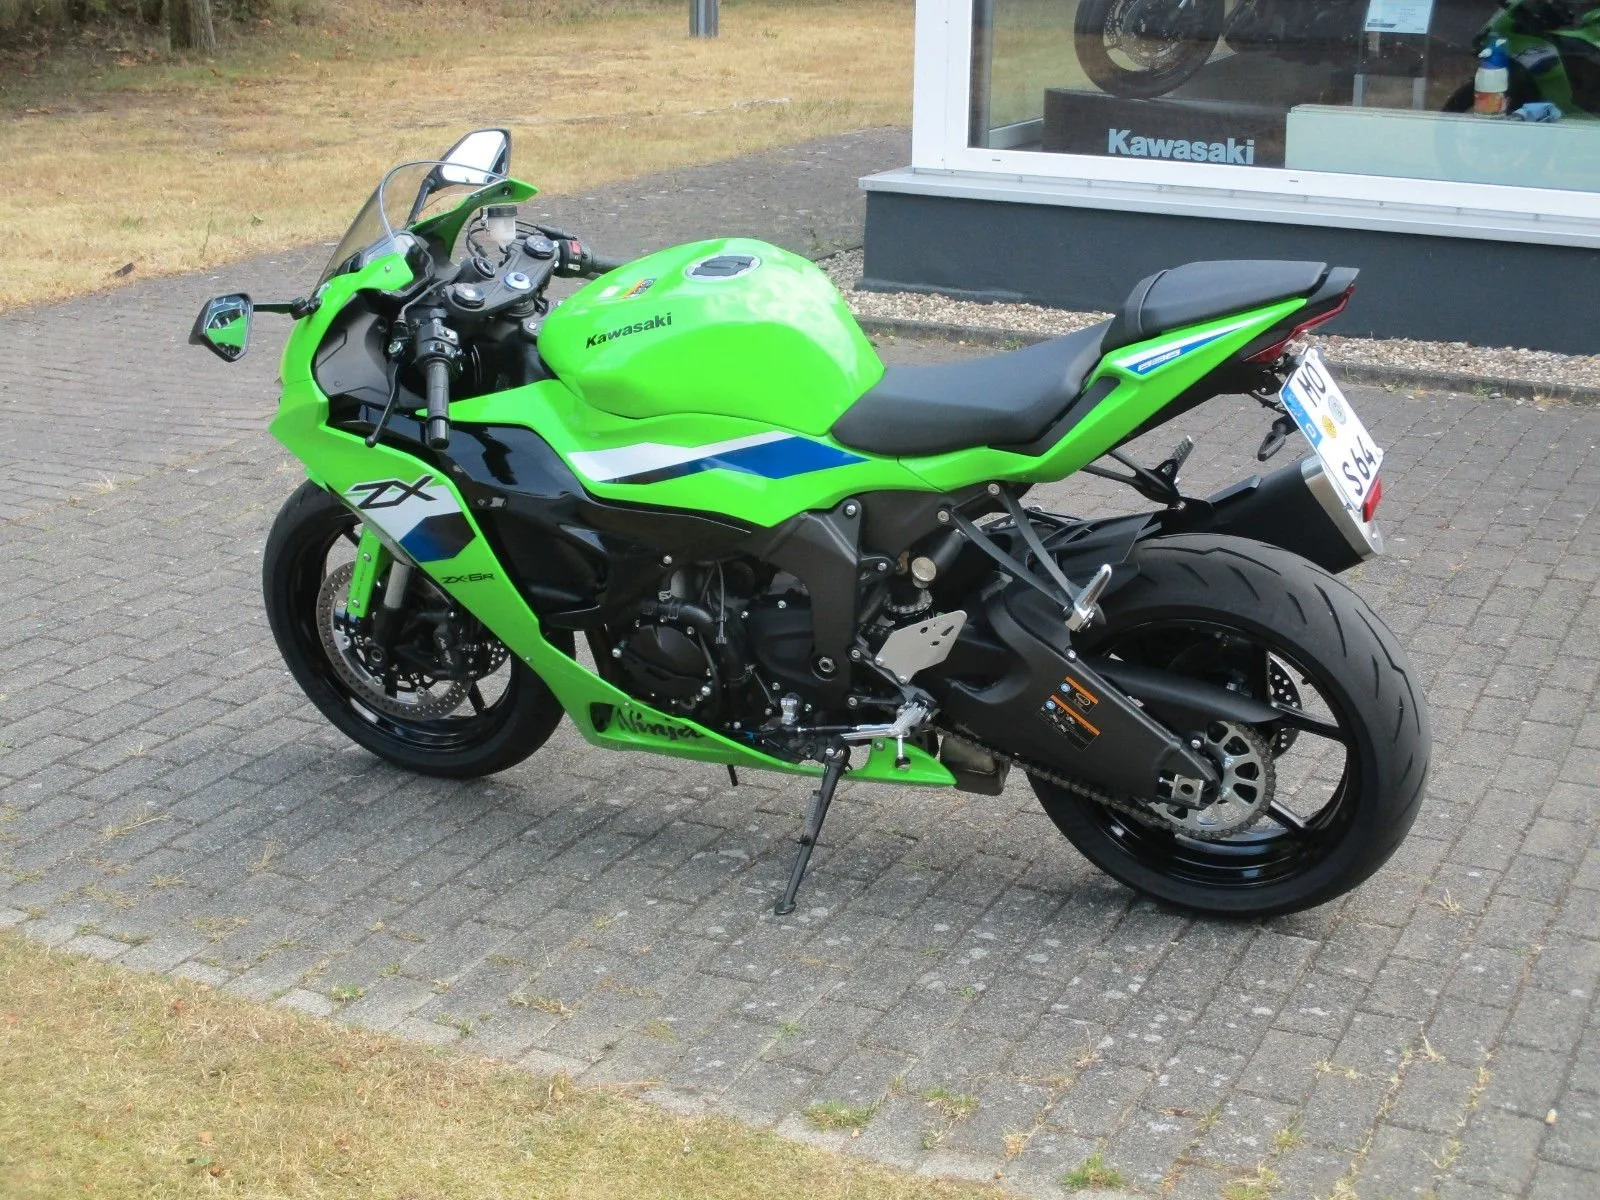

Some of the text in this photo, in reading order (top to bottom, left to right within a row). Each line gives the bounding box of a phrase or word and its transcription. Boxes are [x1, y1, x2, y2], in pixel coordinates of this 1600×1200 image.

[1108, 128, 1255, 165] Kawasaki
[585, 312, 672, 349] Kawasaki
[1297, 361, 1326, 408] MO
[350, 475, 438, 510] ZX
[441, 572, 496, 584] ZX-6R
[616, 706, 706, 740] Ninja
